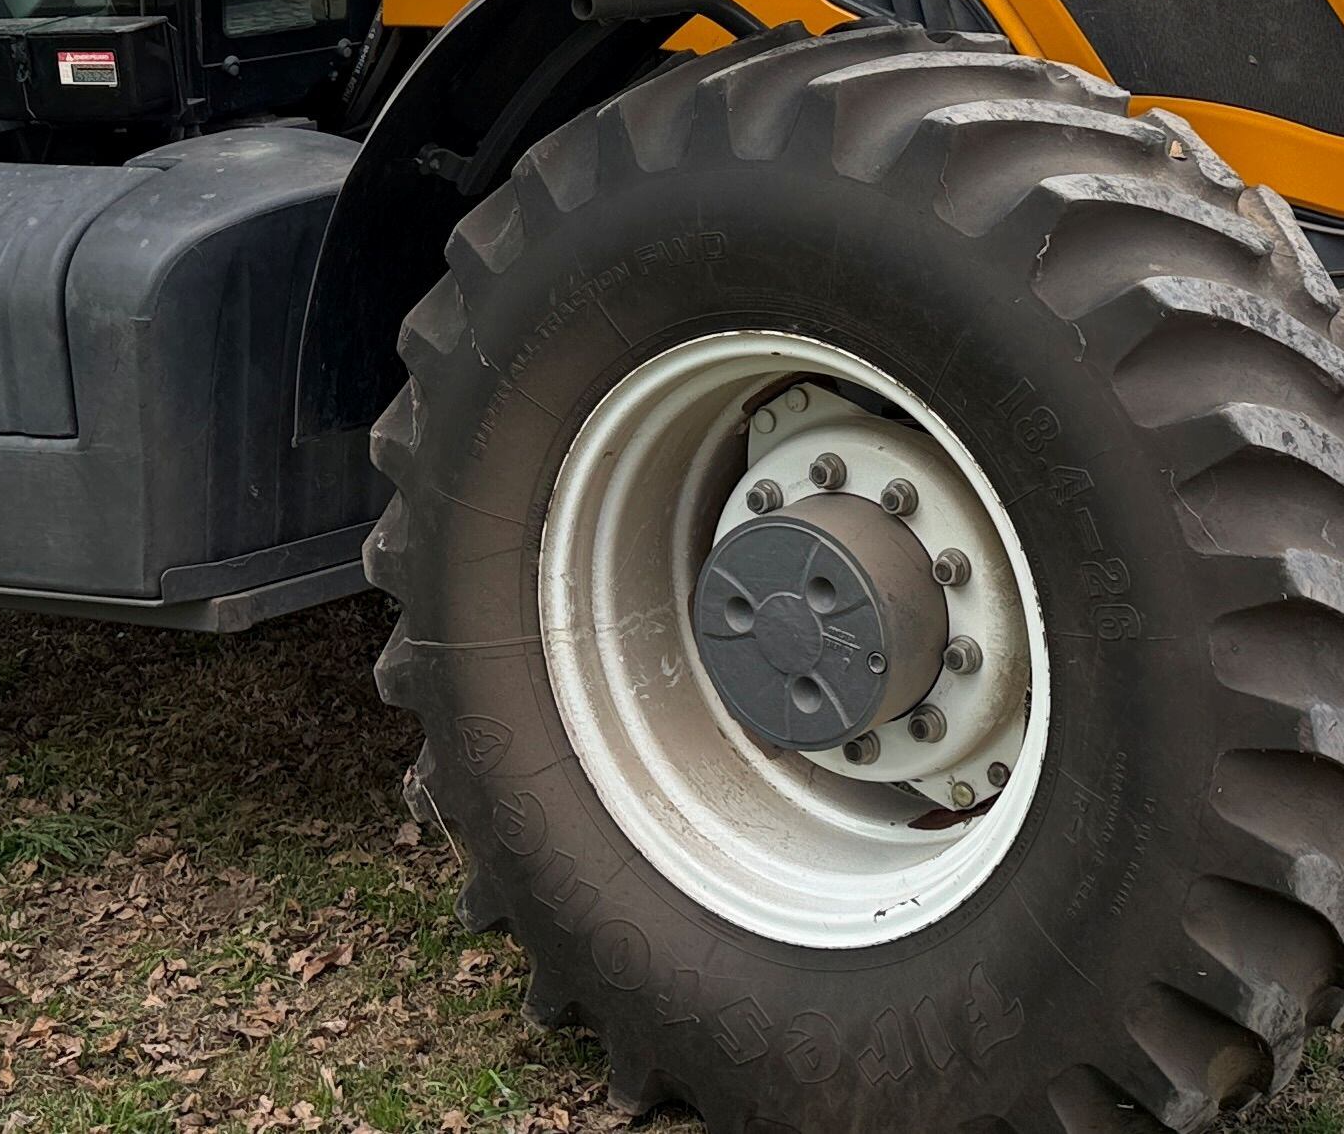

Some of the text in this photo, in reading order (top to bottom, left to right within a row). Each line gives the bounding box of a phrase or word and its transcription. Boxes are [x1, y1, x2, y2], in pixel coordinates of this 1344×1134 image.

[509, 342, 541, 381] ALL
[534, 261, 631, 339] TRACTION
[633, 230, 729, 277] FWD
[490, 789, 1026, 1088] Firestone
